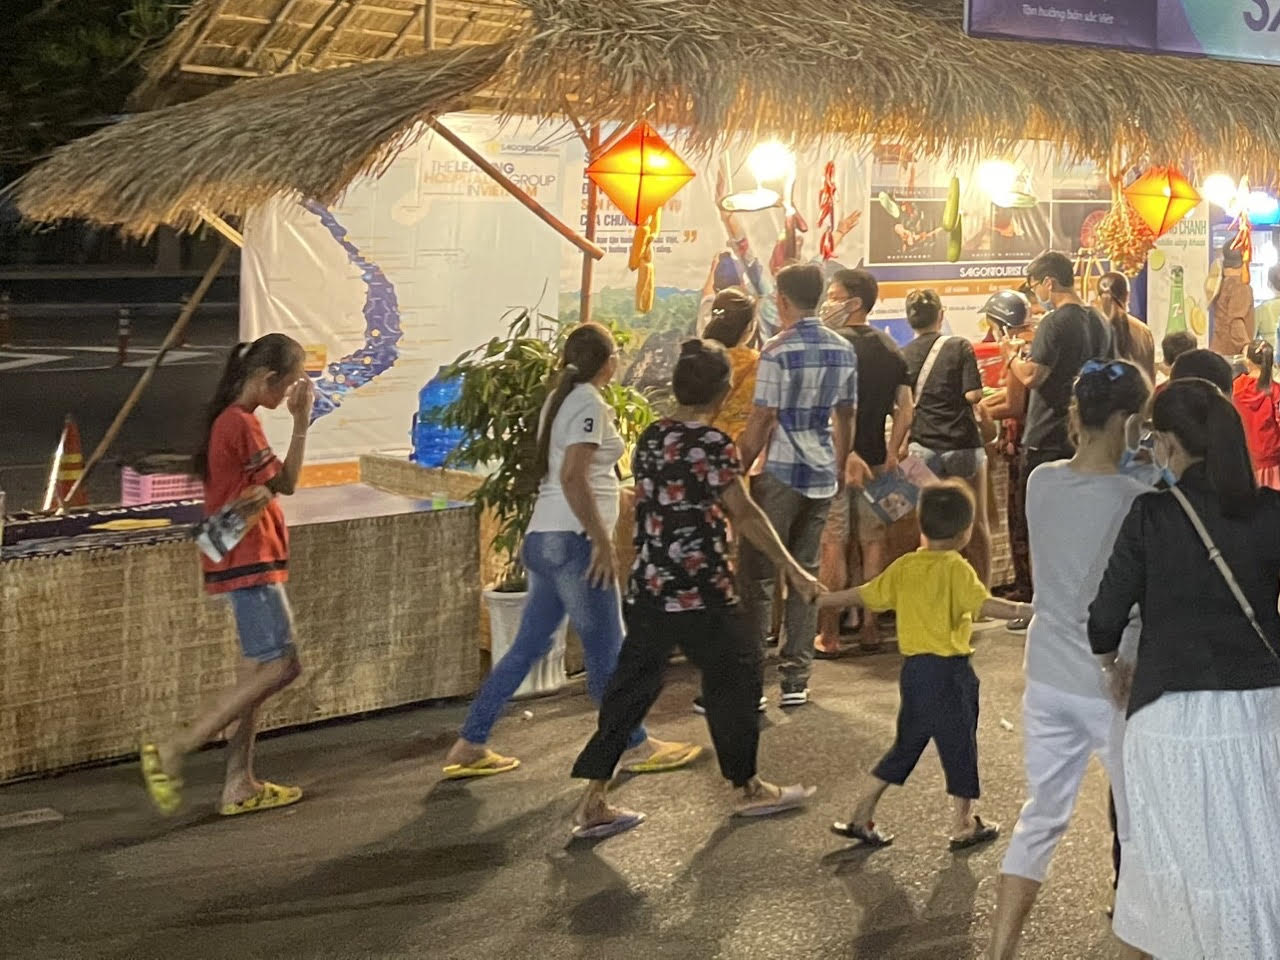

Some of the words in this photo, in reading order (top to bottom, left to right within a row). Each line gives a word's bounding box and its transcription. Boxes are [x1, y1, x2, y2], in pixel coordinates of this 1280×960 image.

[455, 160, 514, 175] LEANG
[510, 175, 556, 186] GROUP
[584, 418, 593, 432] 3
